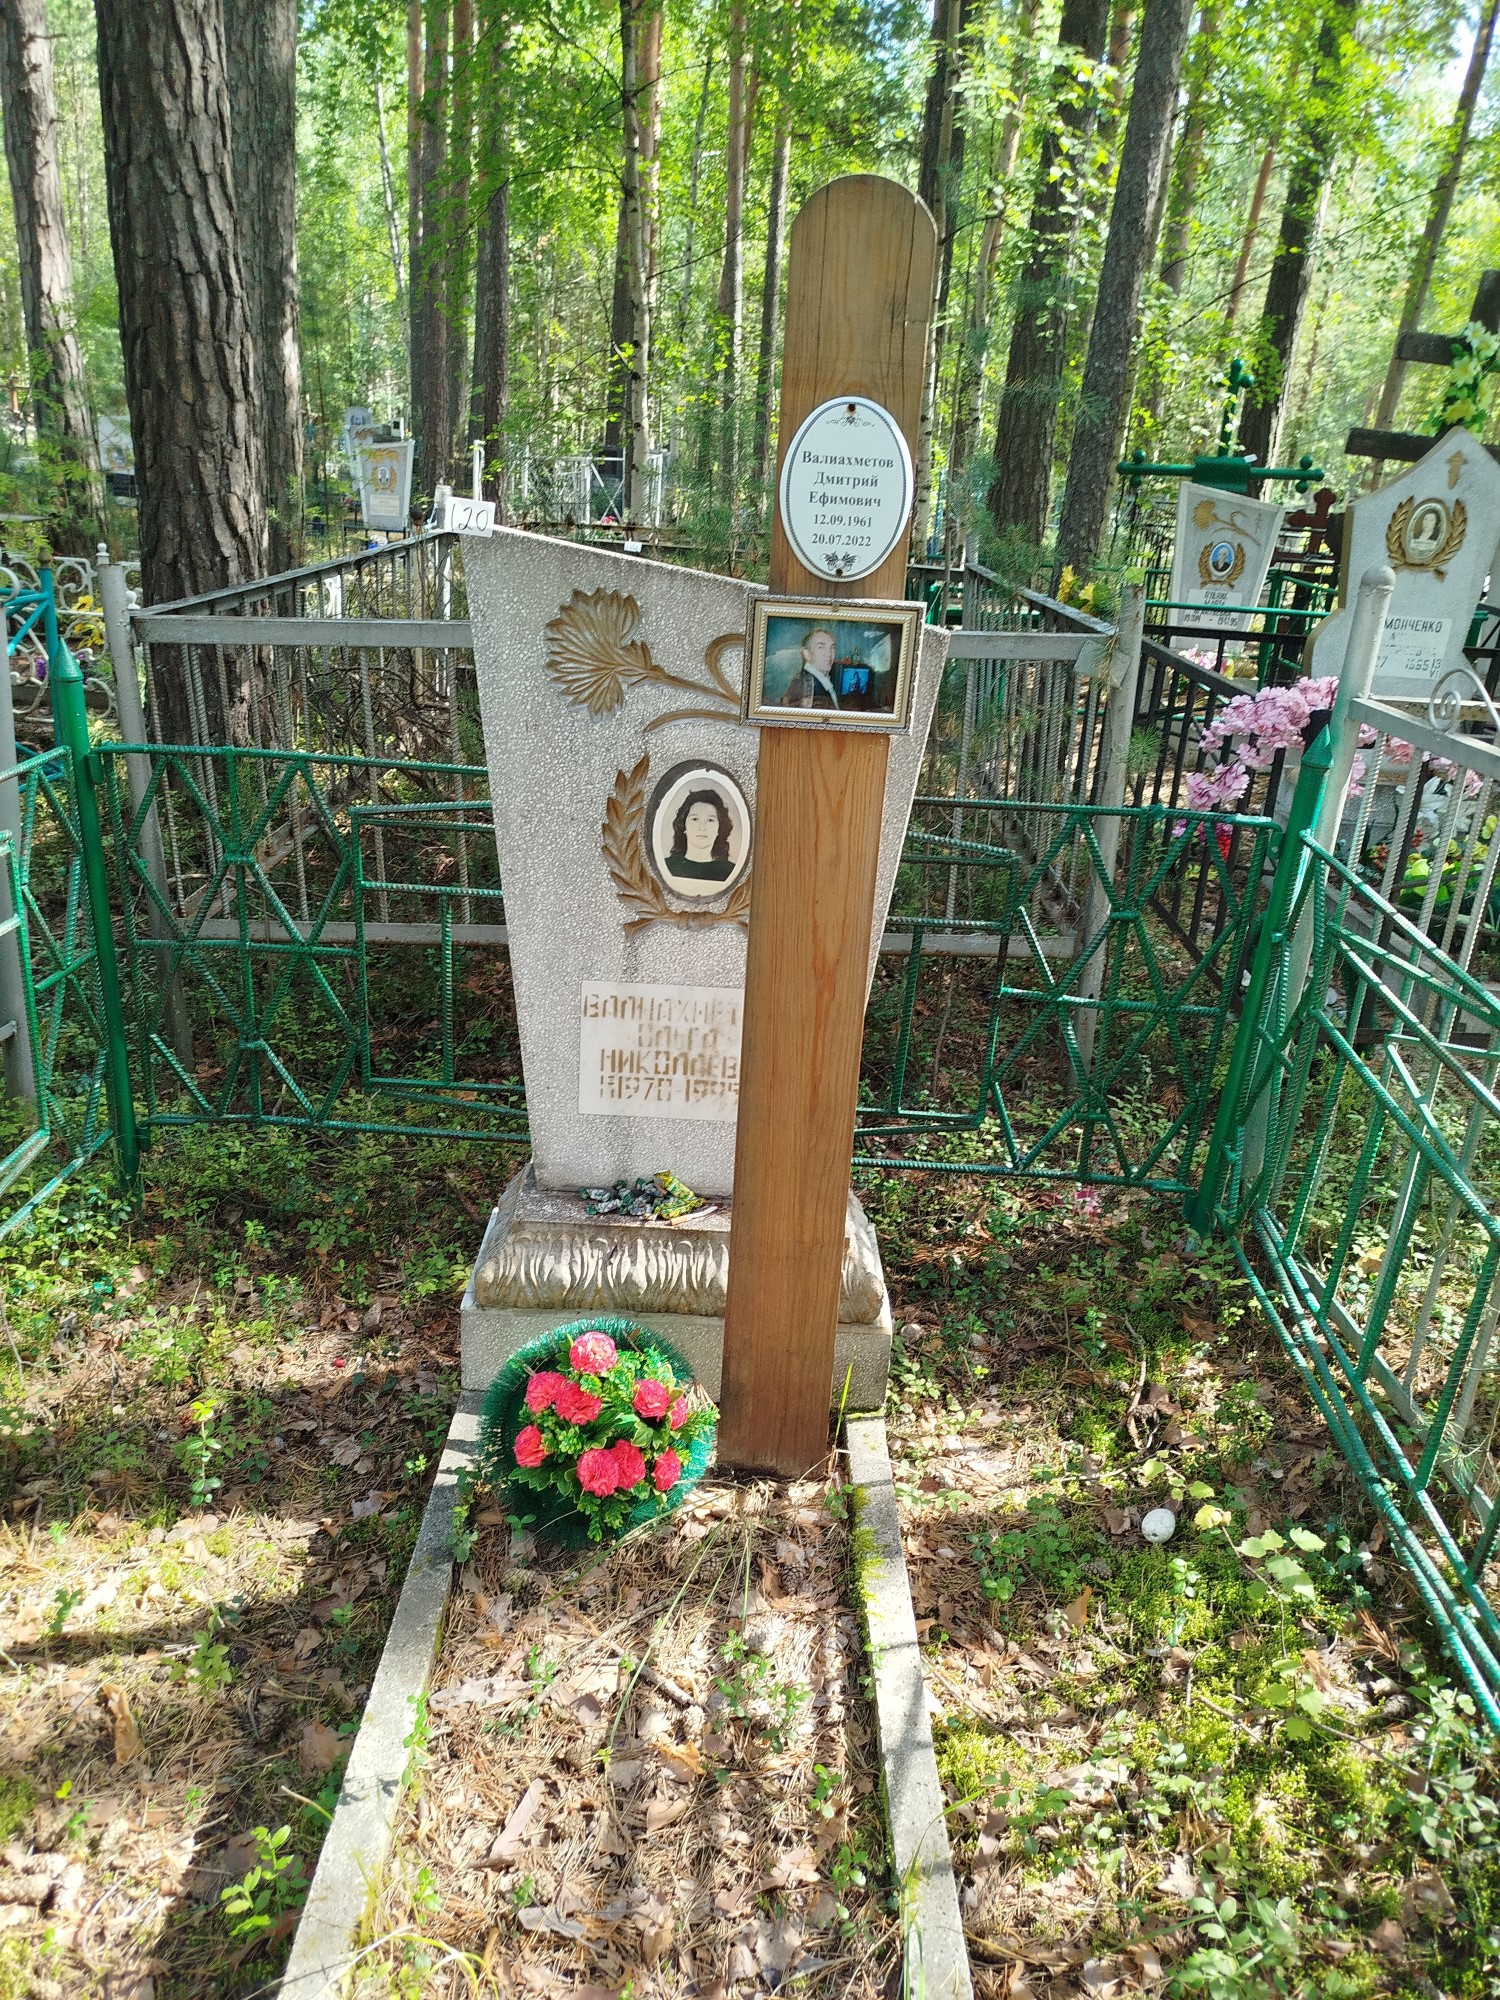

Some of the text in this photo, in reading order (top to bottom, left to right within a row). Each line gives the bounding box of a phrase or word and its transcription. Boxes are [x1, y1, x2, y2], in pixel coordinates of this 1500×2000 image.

[802, 451, 894, 468] Валиахметов
[813, 472, 879, 490] Дмитрий
[809, 491, 881, 508] Ефимович
[451, 503, 489, 532] 120
[813, 514, 872, 528] 12.09.1961
[811, 533, 872, 547] 20.07.2022
